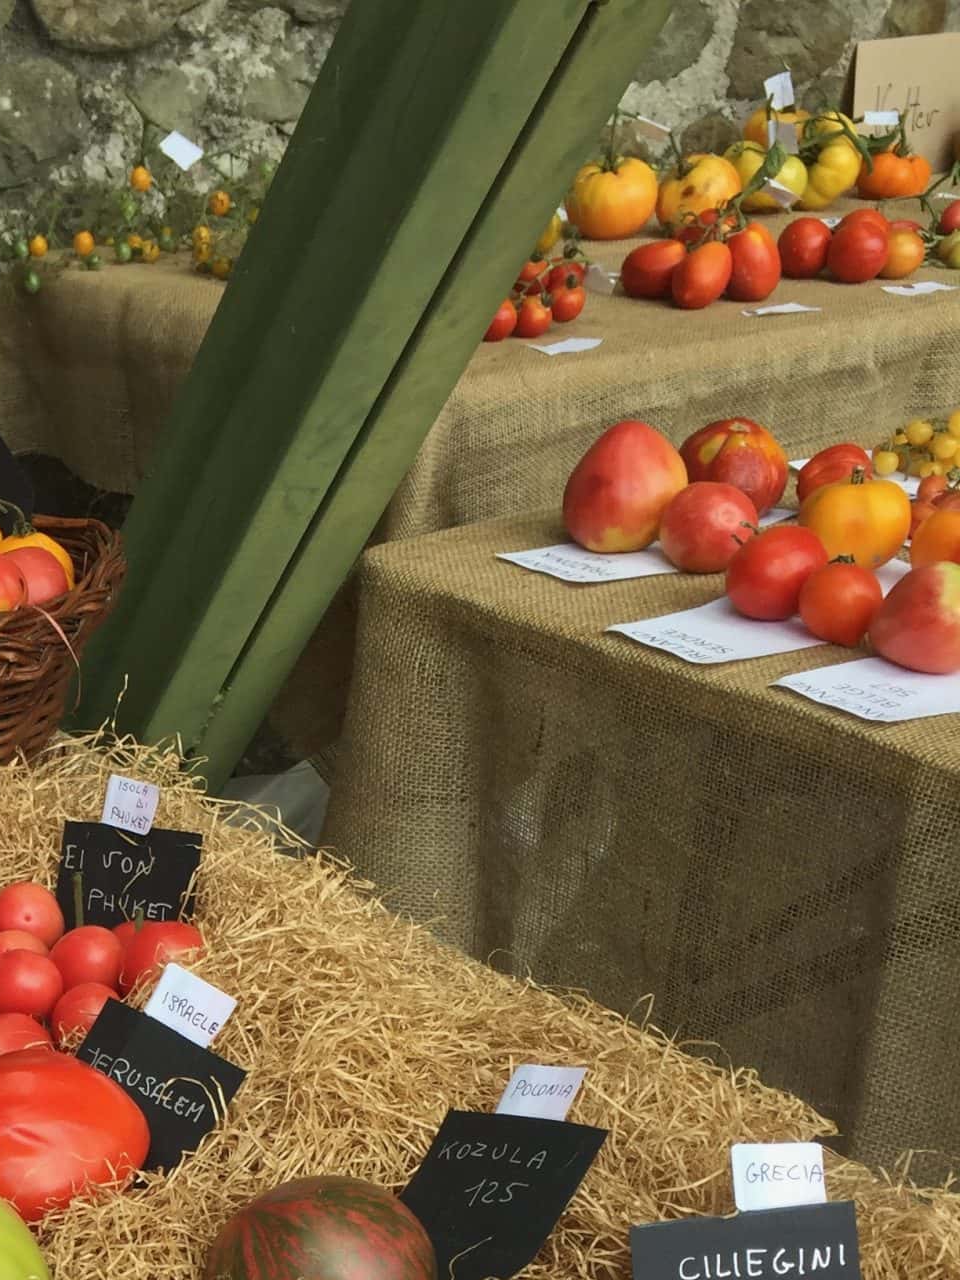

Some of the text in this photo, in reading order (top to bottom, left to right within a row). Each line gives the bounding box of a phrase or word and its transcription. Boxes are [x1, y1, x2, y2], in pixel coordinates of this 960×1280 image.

[119, 781, 147, 796] ISOLA
[111, 806, 149, 830] PHUKET
[65, 844, 155, 874] EI VON
[88, 888, 172, 921] PHUKET
[162, 991, 219, 1035] ISRAELE
[88, 1048, 205, 1122] JERUSALEM
[512, 1079, 574, 1098] POLONIA
[438, 1141, 547, 1169] KOZULA
[746, 1161, 823, 1183] GRECIA
[464, 1178, 529, 1207] 125
[679, 1244, 846, 1280] CILIEGINI
